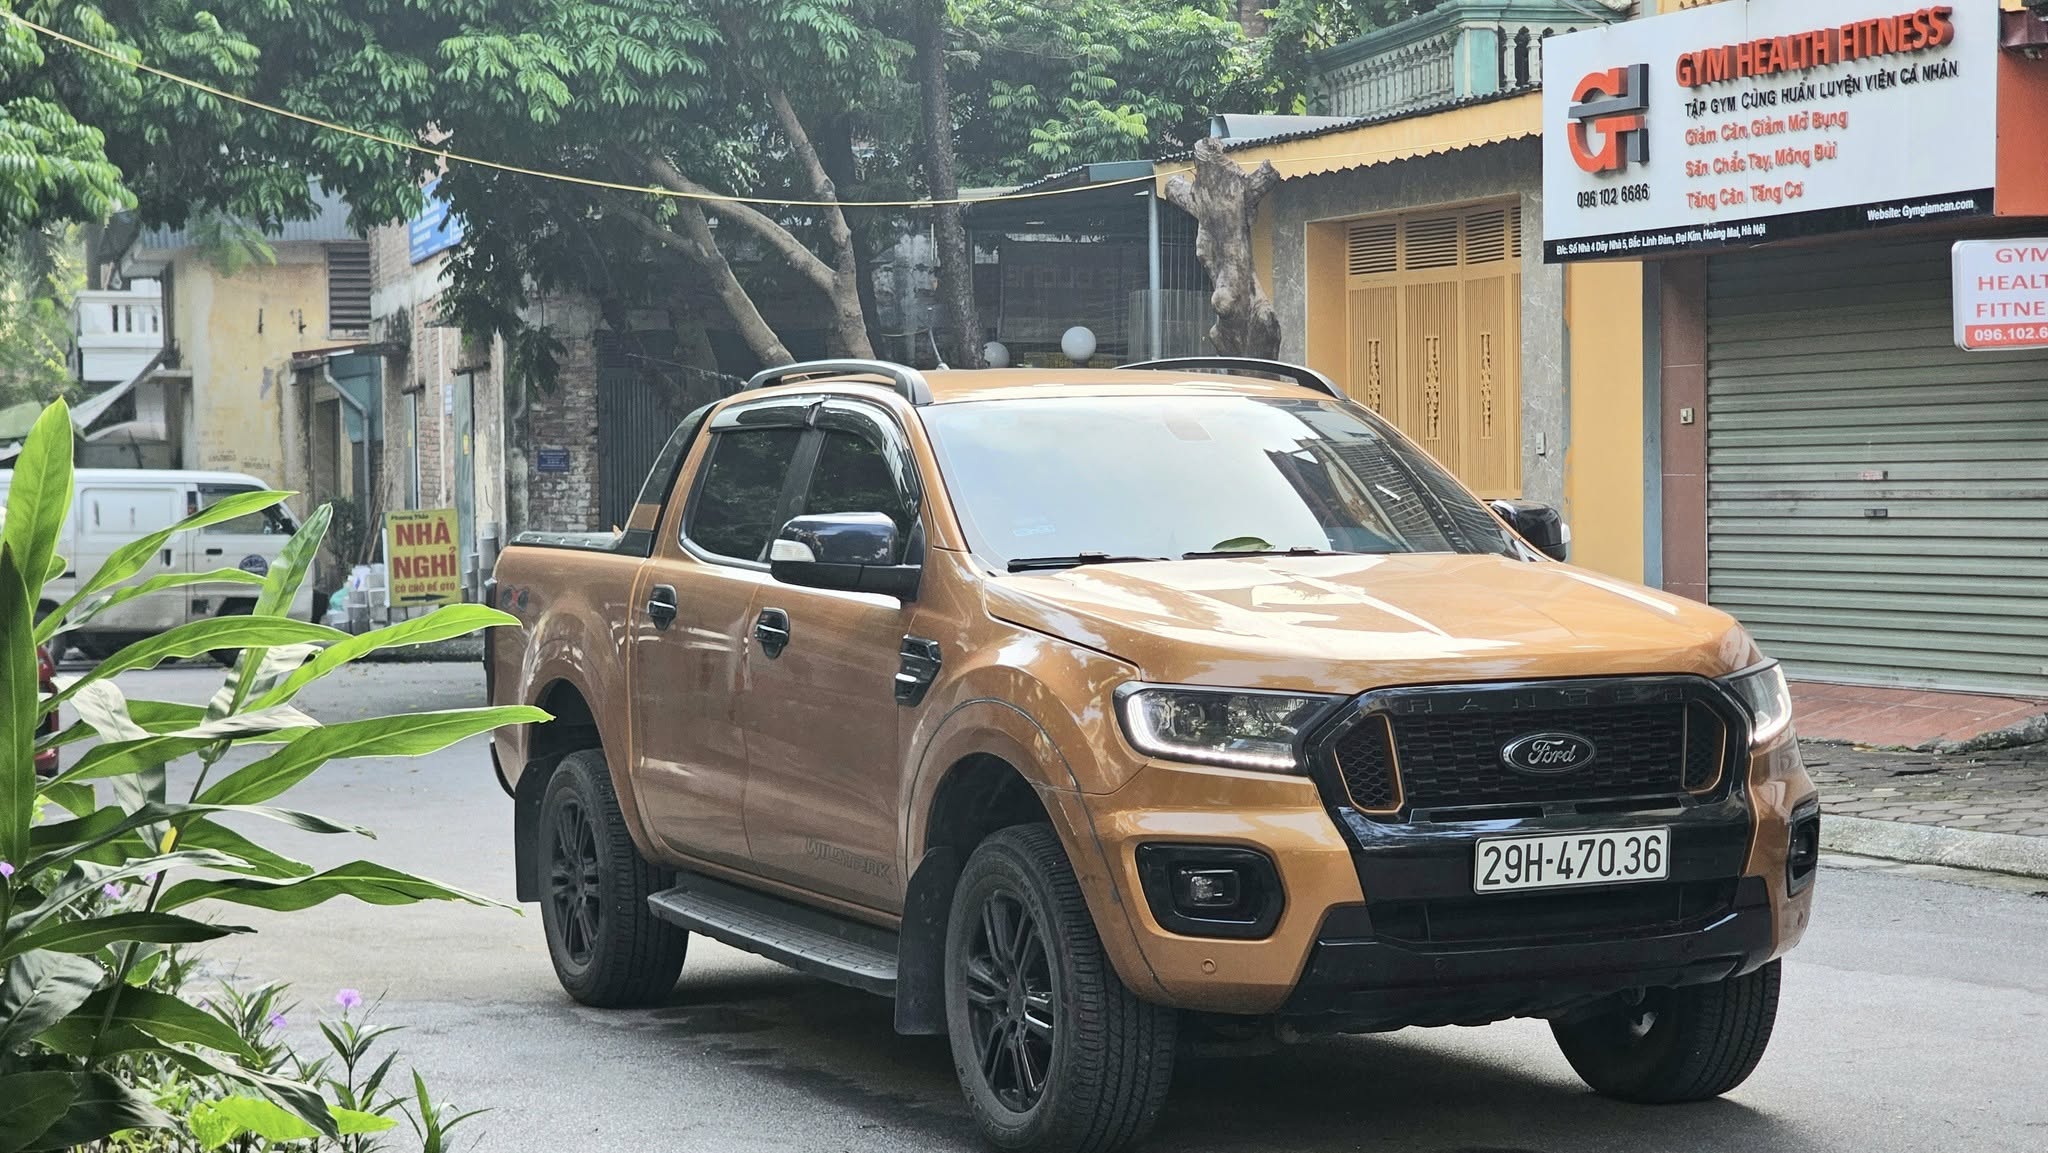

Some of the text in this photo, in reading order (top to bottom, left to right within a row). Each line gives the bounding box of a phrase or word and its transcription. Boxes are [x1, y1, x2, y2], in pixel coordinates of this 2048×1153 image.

[1676, 6, 1953, 88] GYM HEALTH FITNESS
[1685, 98, 1707, 119] TẬP
[1711, 95, 1736, 113] GYM
[1741, 87, 1777, 110] CÙNG
[1820, 74, 1861, 97] LUYỆN
[1865, 67, 1896, 91] VIÊN
[1900, 62, 1918, 84] CÁ
[1922, 58, 1959, 82] NHÂN
[1685, 125, 1717, 146] Giảm
[1751, 116, 1785, 137] Giảm
[1812, 111, 1849, 132] Bụng
[1713, 150, 1747, 175] Chắc
[1775, 147, 1811, 168] Mông
[1577, 183, 1650, 208] 096 102 6686
[1686, 190, 1717, 211] Tăng
[1750, 184, 1783, 204] Tăng
[1866, 199, 1974, 221] Website: Gymgiamcan.com
[1568, 241, 1578, 254] Số
[1578, 242, 1591, 253] Nhà
[1591, 241, 1596, 252] 4
[1609, 239, 1622, 250] Nhà
[1703, 227, 1726, 241] Hoàng
[1741, 224, 1752, 236] Hà
[1995, 247, 2048, 263] GYM
[395, 516, 451, 546] NHÀ
[392, 546, 457, 580] NGHỈ
[1527, 739, 1577, 765] Ford
[1481, 834, 1663, 886] 29H-470.36
